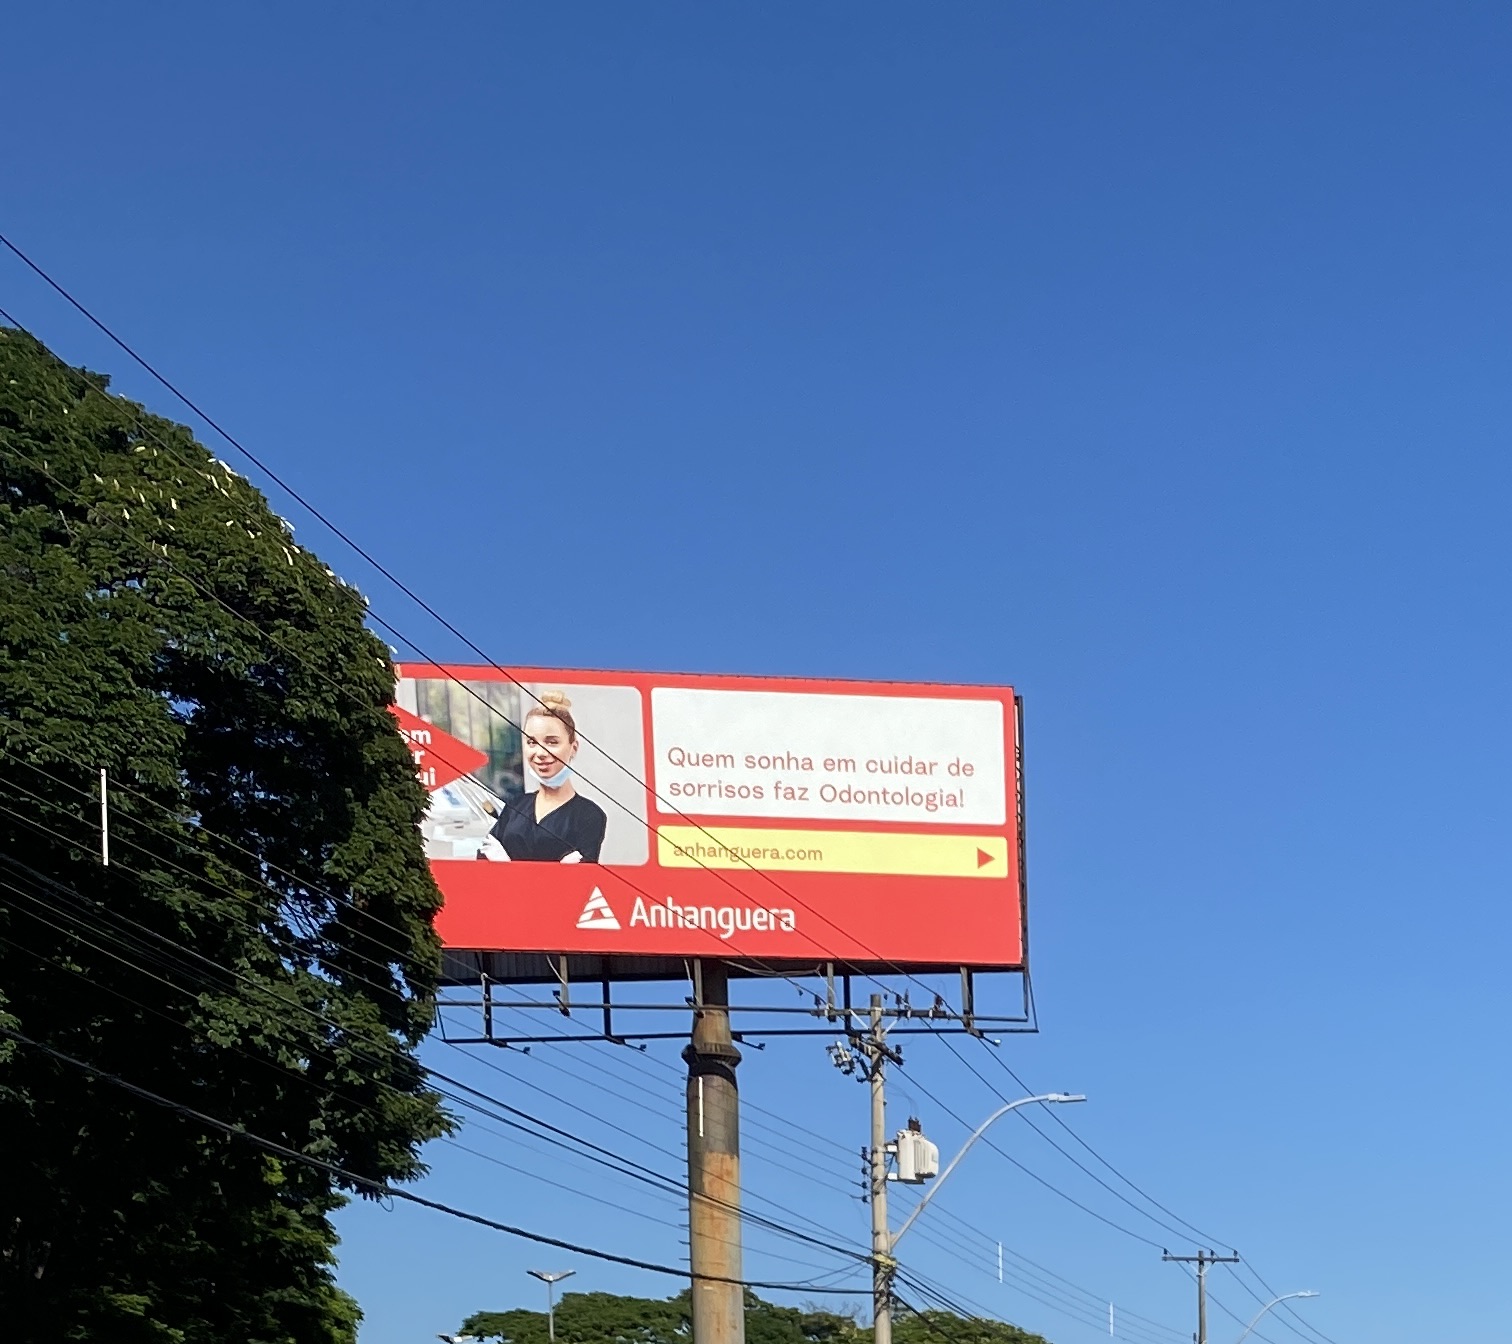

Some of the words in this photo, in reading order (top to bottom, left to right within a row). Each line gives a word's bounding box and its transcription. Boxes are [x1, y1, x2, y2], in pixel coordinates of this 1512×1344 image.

[668, 747, 735, 769] Quem
[744, 751, 814, 771] sonha
[823, 758, 856, 773] em
[865, 755, 938, 776] cuidar
[947, 757, 975, 777] de
[669, 780, 764, 799] sorrisos
[773, 781, 809, 801] faz
[819, 784, 965, 812] Odontologia!
[673, 842, 823, 863] anhanguera.com
[629, 896, 796, 939] Anhanguera
